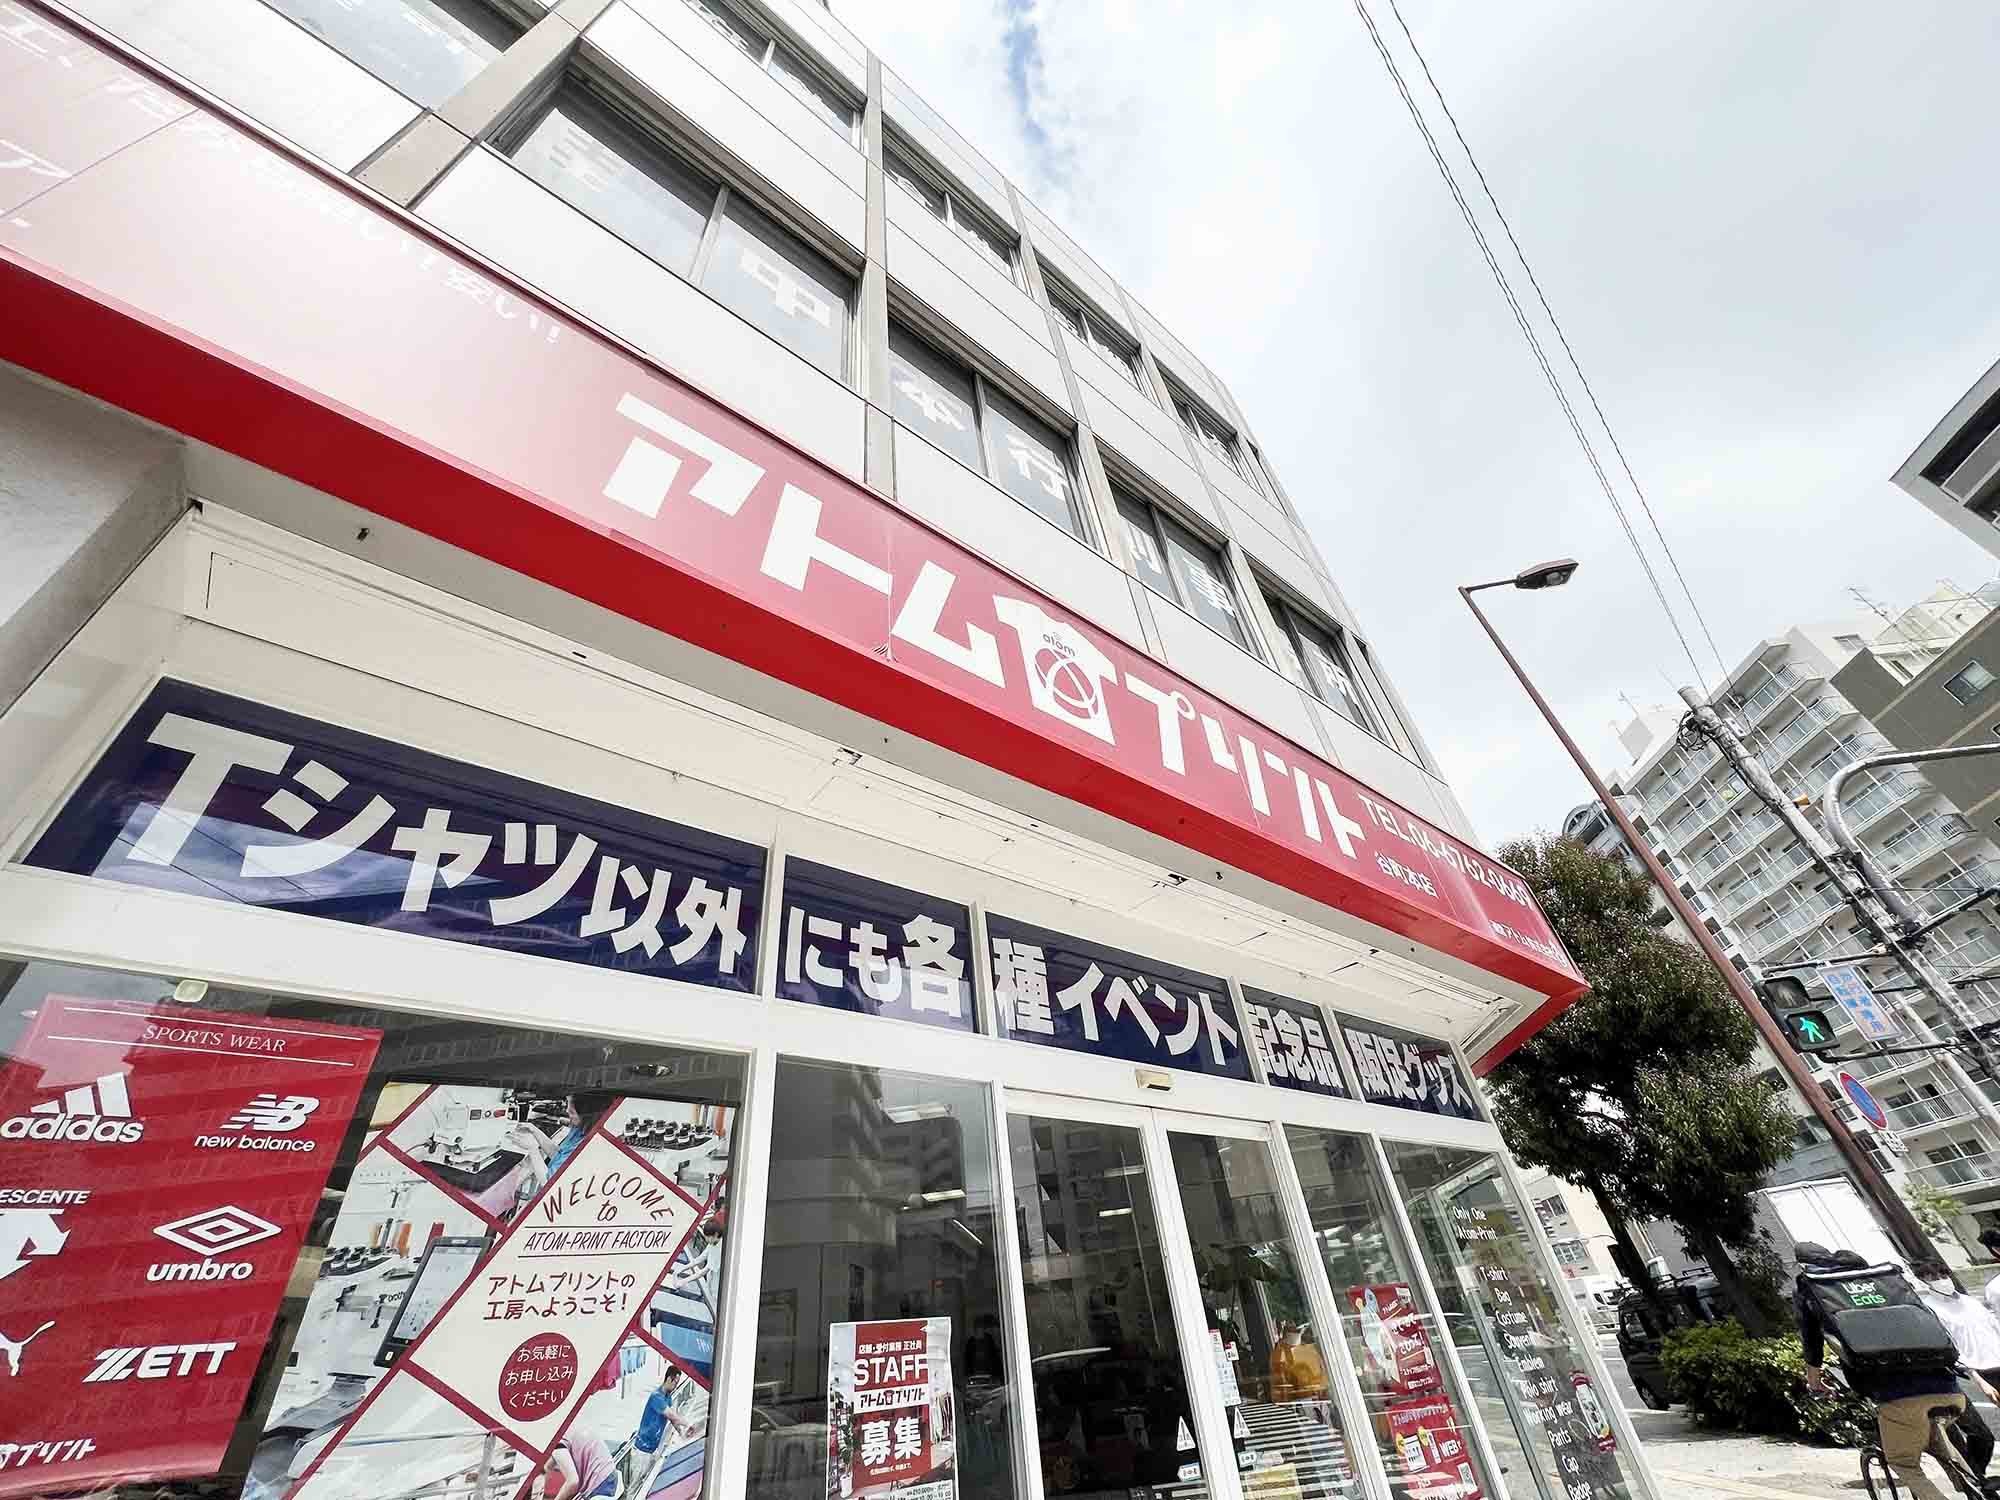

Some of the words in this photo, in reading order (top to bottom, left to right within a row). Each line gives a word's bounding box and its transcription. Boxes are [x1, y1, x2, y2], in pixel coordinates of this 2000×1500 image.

[603, 392, 1006, 690] アトム
[1124, 670, 1366, 860] プリント
[1042, 633, 1076, 657] atom
[126, 711, 749, 974] Tシャツ以外
[143, 1024, 224, 1048] SPORTS
[229, 1034, 287, 1053] WEAR
[0, 1114, 145, 1144] adidas
[194, 1134, 235, 1149] new
[238, 1134, 316, 1153] balance
[543, 1172, 675, 1223] WELCOME
[595, 1199, 618, 1222] to
[524, 1232, 612, 1252] ATOM-PRINT
[613, 1230, 671, 1248] FACTORY
[145, 1258, 254, 1282] umbro
[487, 1271, 636, 1297] アトムプリントの
[1841, 1281, 1877, 1294] Uber
[1850, 1293, 1886, 1305] Eats
[82, 1342, 236, 1384] ZETT
[517, 1344, 572, 1363] お気軽に
[505, 1366, 575, 1386] お申し込み
[854, 1353, 929, 1386] STAFF
[509, 1390, 565, 1409] ください
[860, 1416, 922, 1467] 募集
[1547, 1427, 1572, 1448] Pants
[1562, 1455, 1580, 1476] Cap
